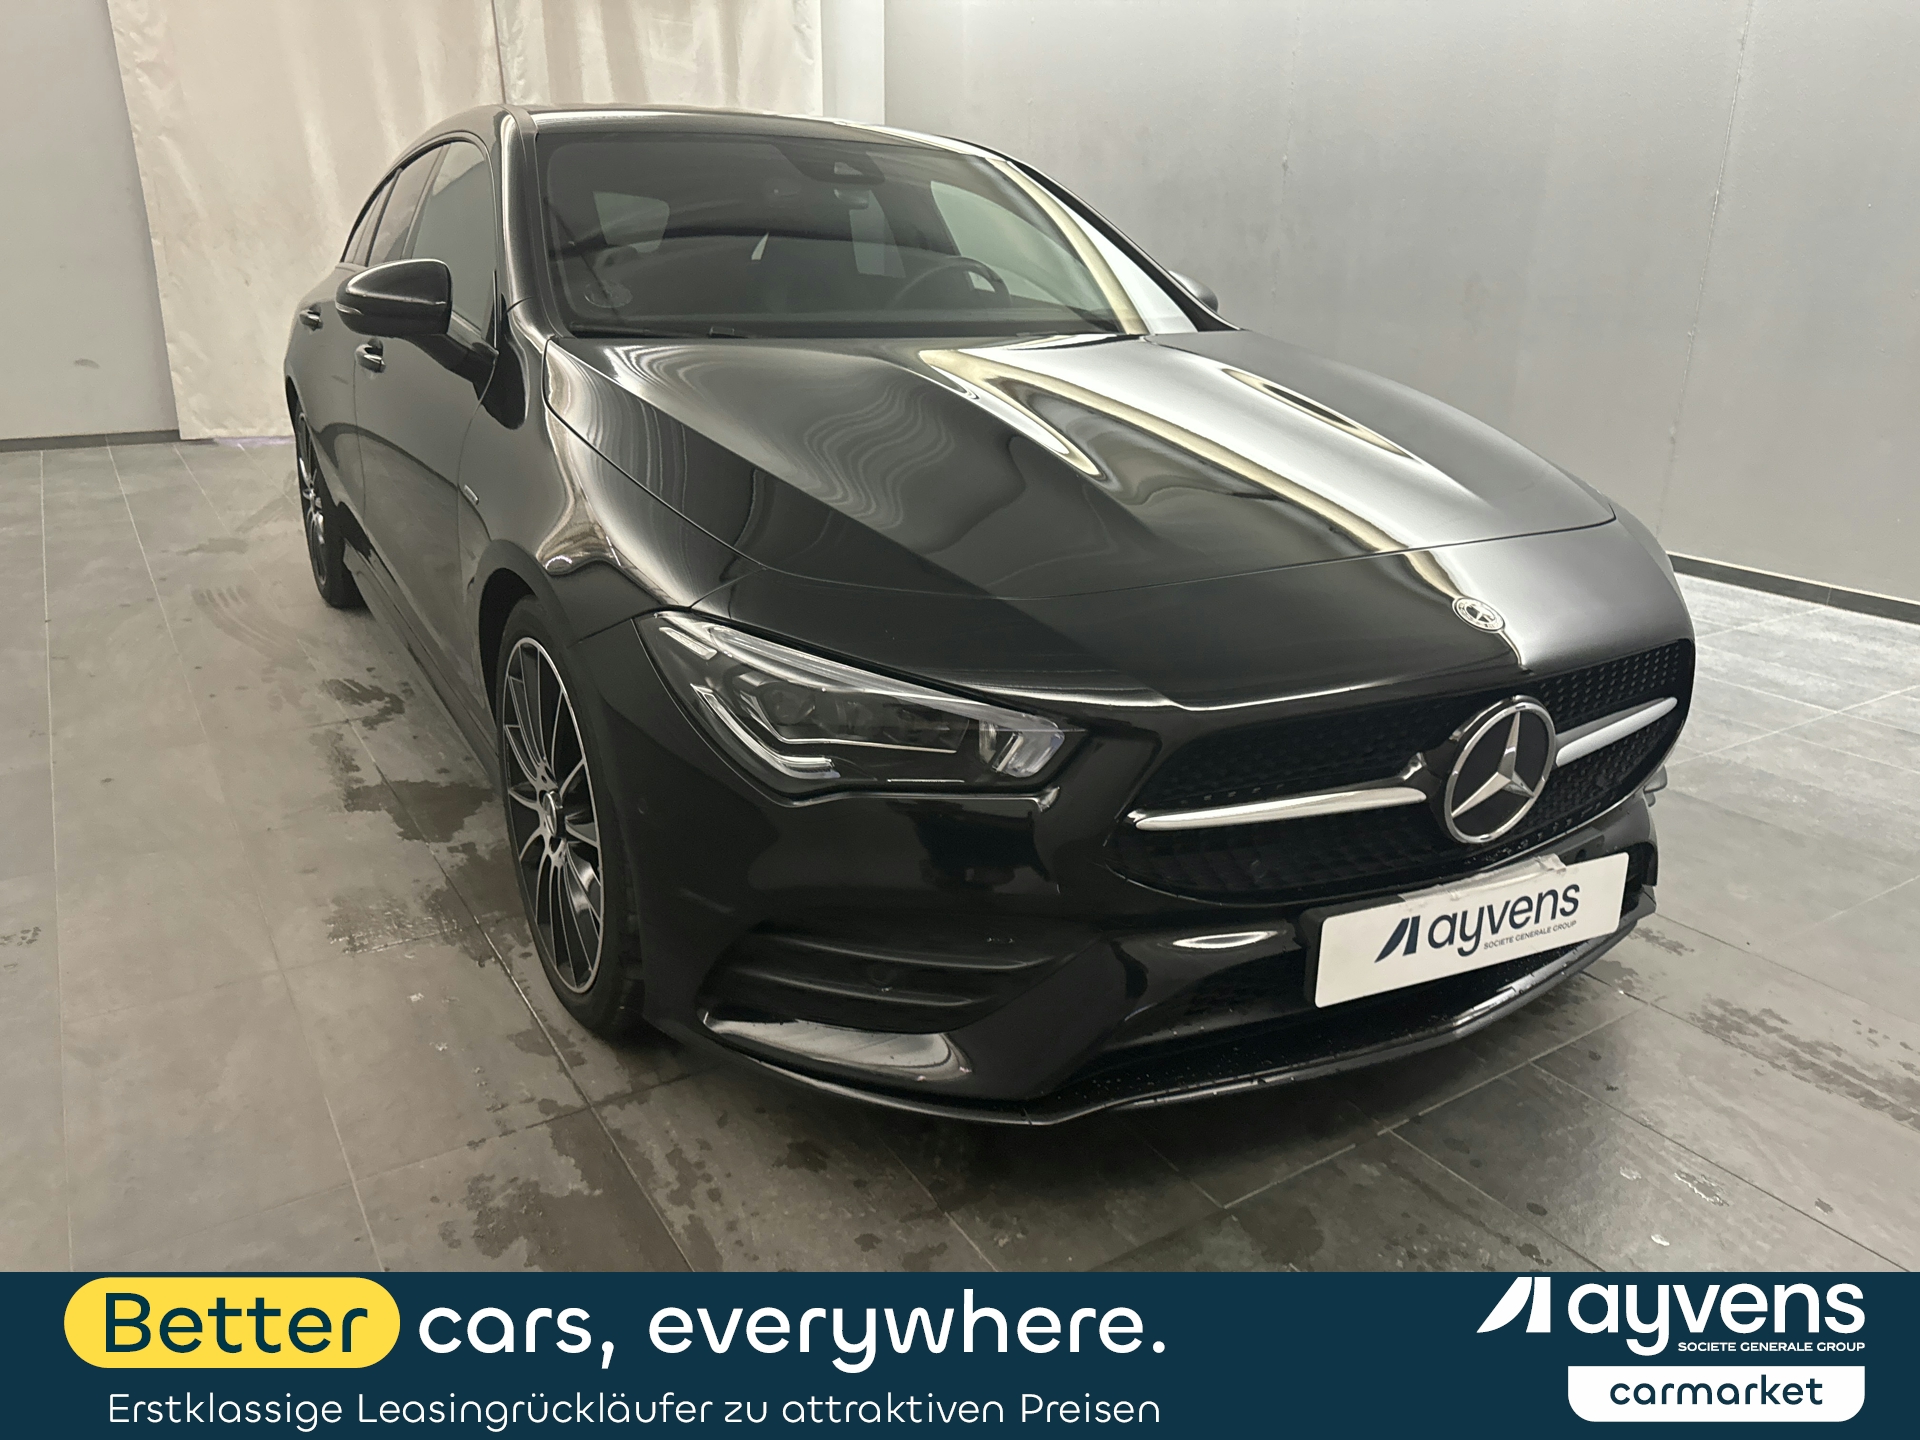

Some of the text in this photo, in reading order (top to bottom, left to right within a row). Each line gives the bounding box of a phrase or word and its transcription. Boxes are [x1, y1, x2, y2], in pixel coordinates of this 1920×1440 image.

[1427, 883, 1581, 957] ayvens
[1483, 919, 1577, 950] SOCIETE GENERALE GROUP
